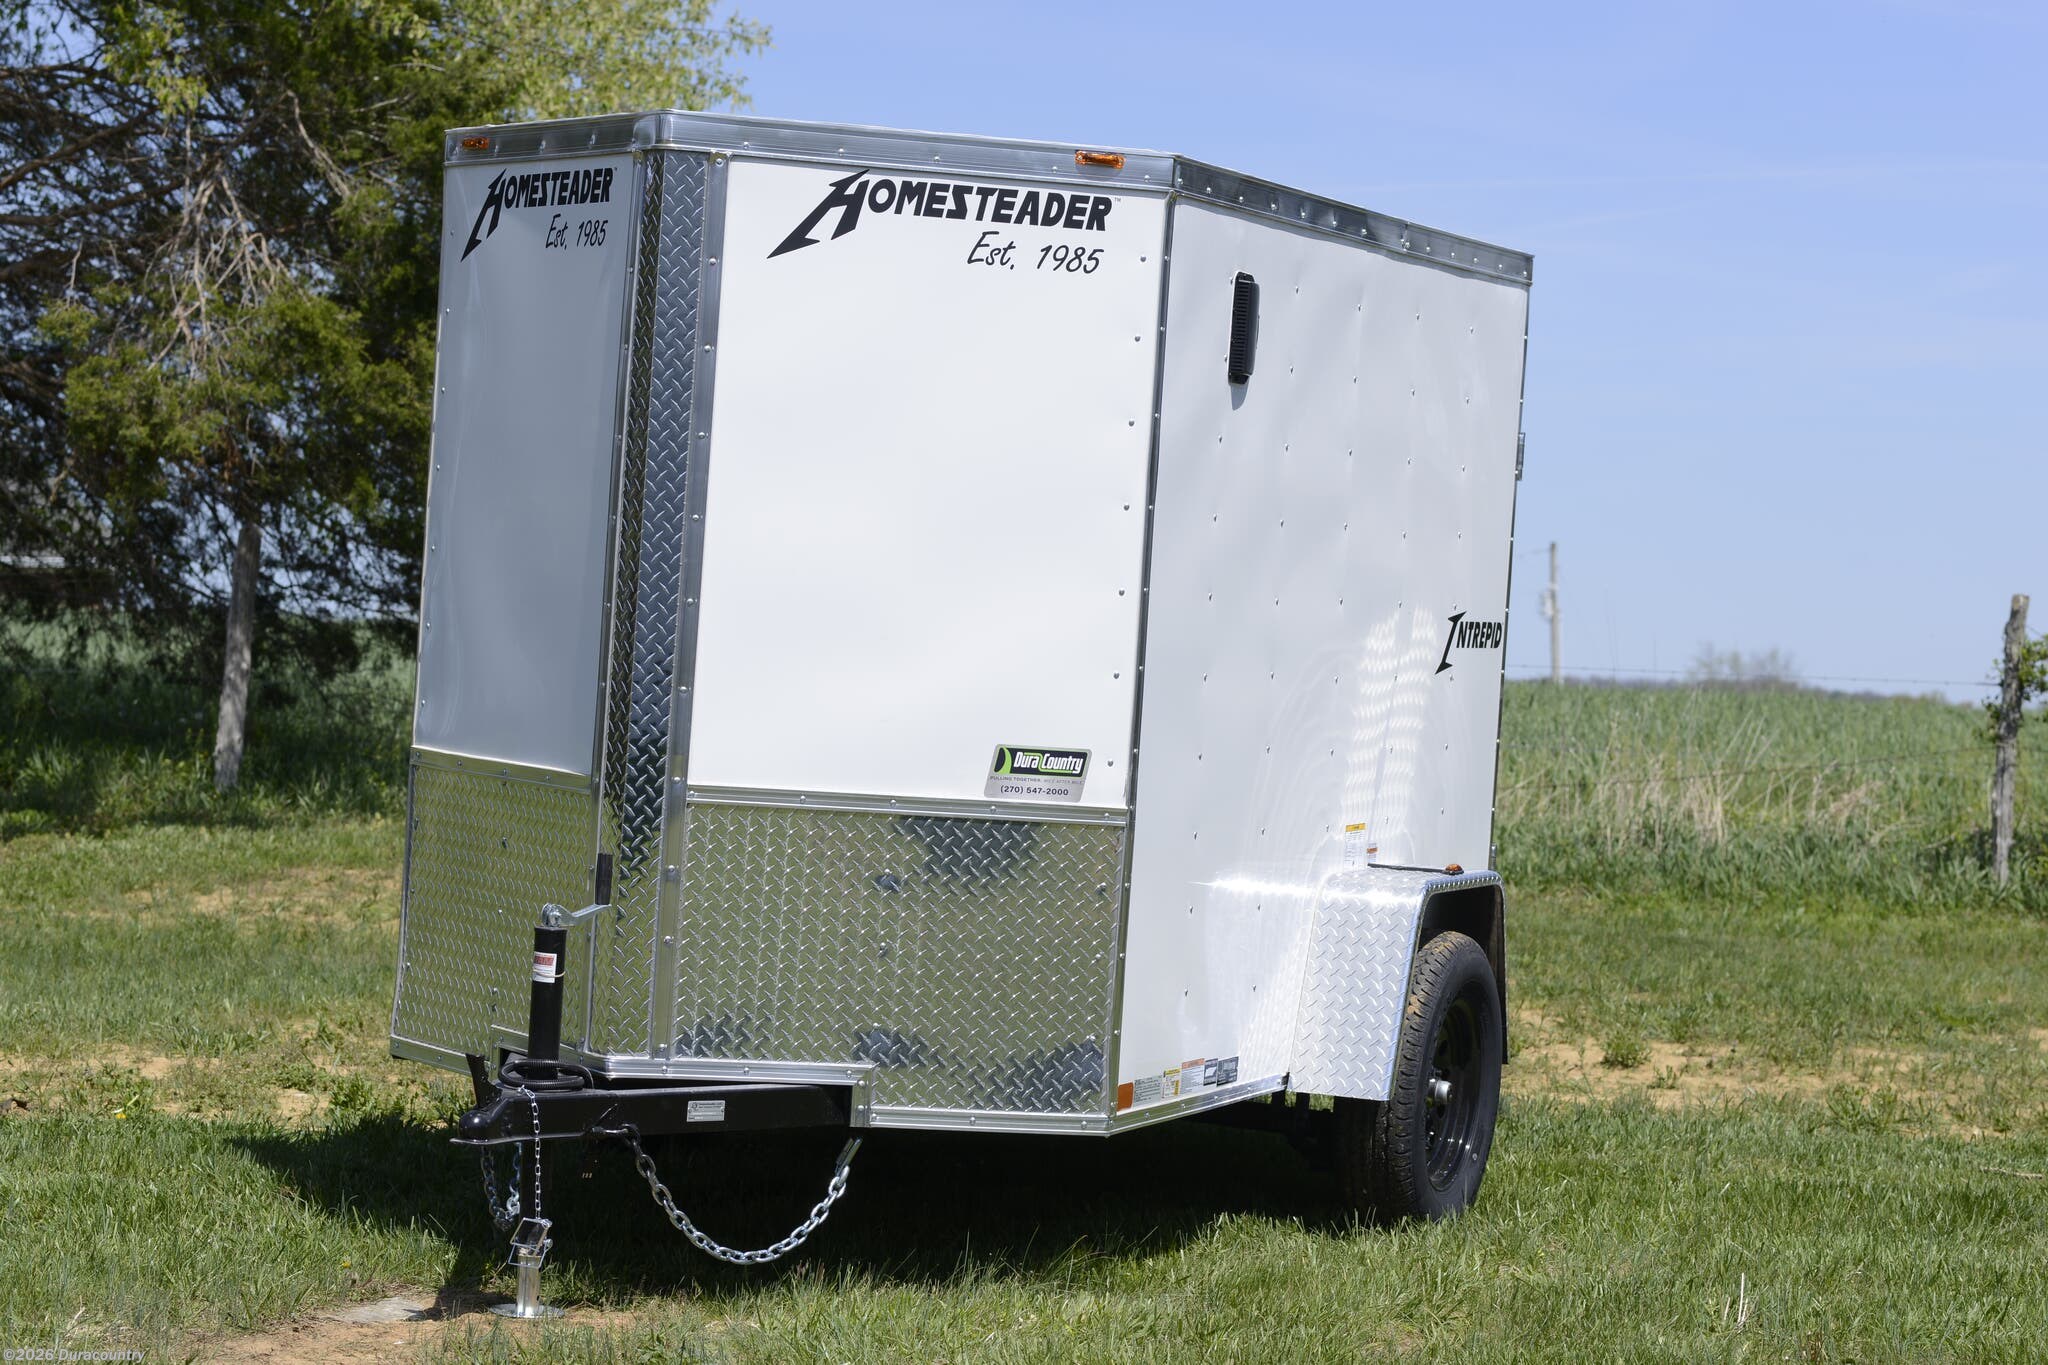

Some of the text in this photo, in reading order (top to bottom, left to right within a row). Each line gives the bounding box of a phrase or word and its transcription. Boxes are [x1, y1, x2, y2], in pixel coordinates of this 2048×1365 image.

[460, 168, 614, 262] HOMESTEADER
[576, 220, 609, 247] 1985
[766, 169, 1113, 259] HOMESTEADER
[966, 230, 1105, 274] Est. 1985
[1434, 611, 1503, 675] INTREPID
[1000, 785, 1069, 796] (270) 547-2000
